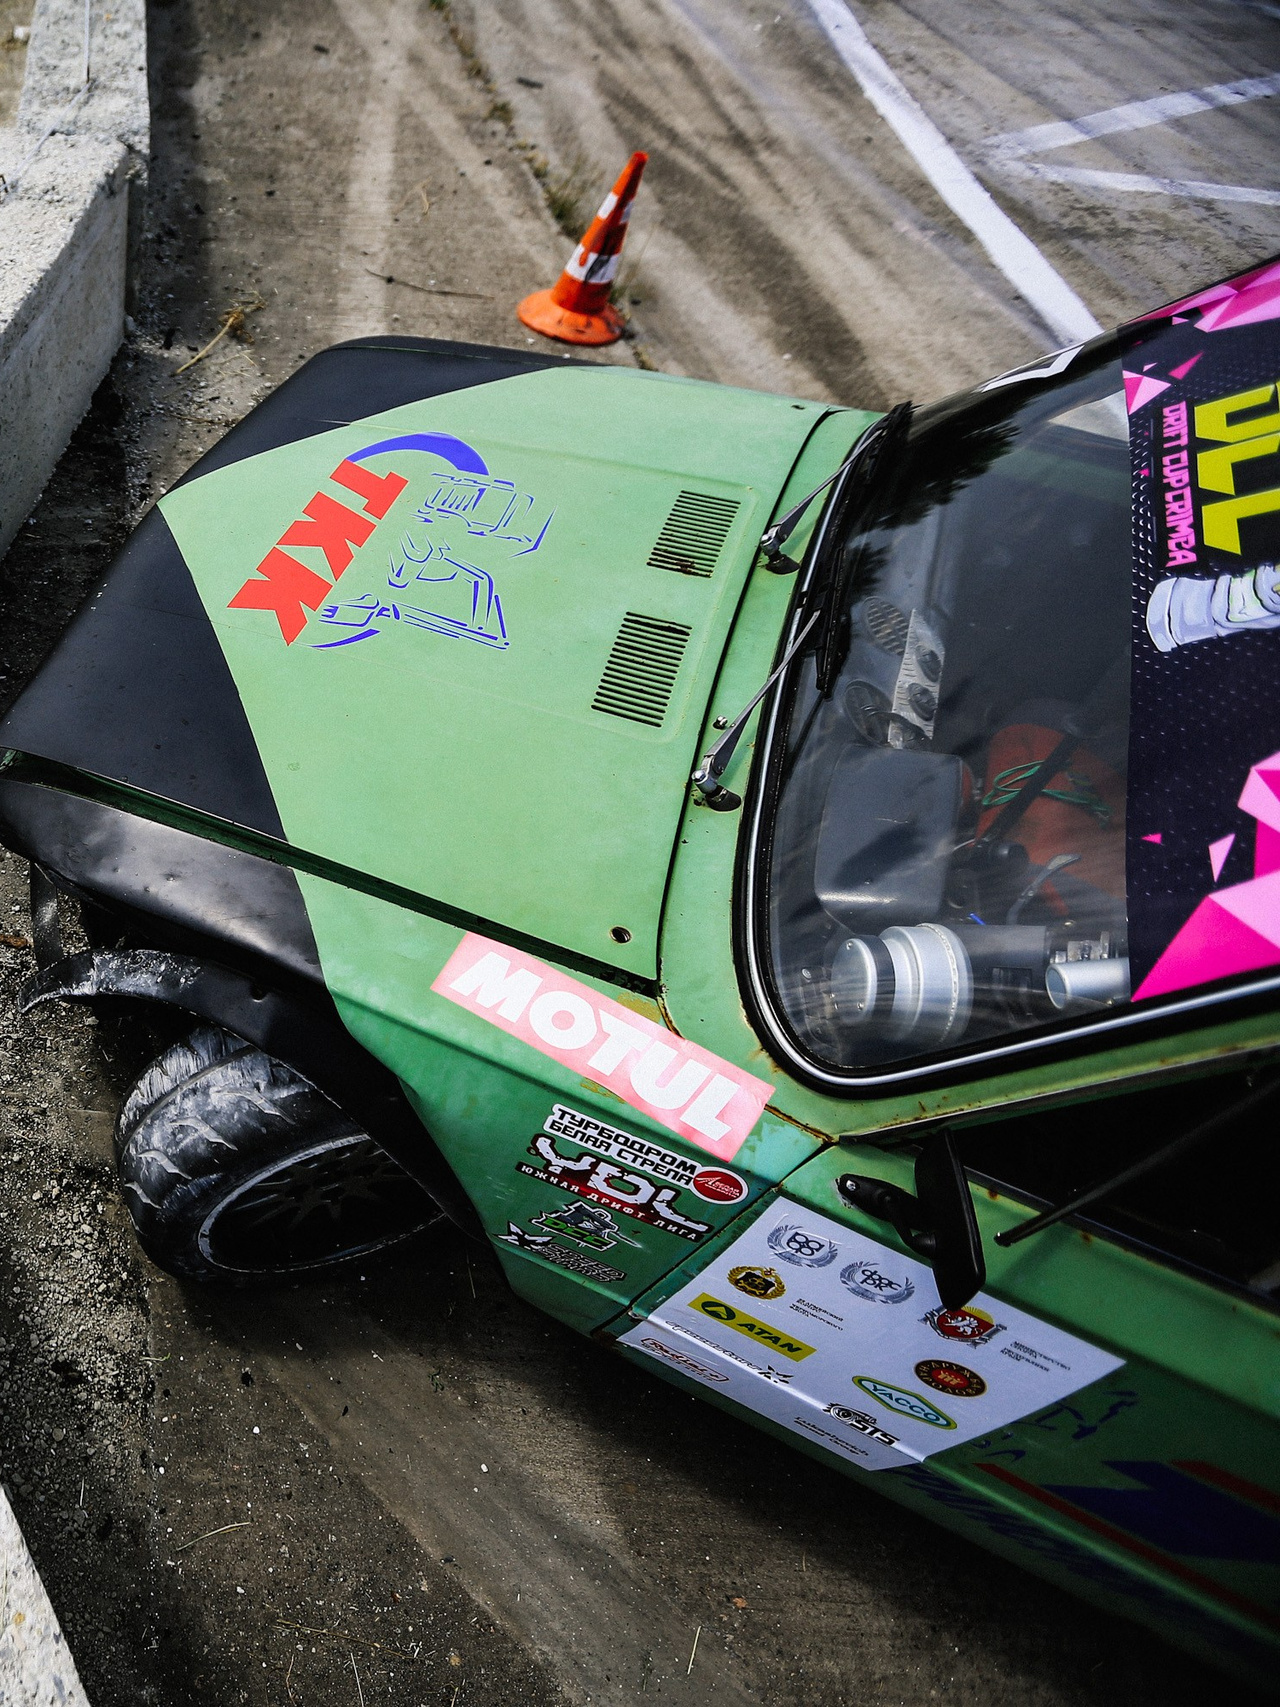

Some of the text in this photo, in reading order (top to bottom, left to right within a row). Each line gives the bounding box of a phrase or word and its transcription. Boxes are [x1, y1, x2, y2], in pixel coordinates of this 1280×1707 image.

[1162, 400, 1197, 567] DRIFT CUP CRIMEA
[449, 951, 741, 1142] MOTUL
[549, 1120, 694, 1186] БЕЛАЯ СТРЕЛА
[557, 1108, 697, 1176] ТУРБОДРОМ
[521, 1165, 697, 1240] ЮЖНАЯ ДРИФТ ЛИГА
[737, 1322, 802, 1353] ATAN
[849, 1419, 900, 1446] STS
[872, 1384, 941, 1423] YACCO
